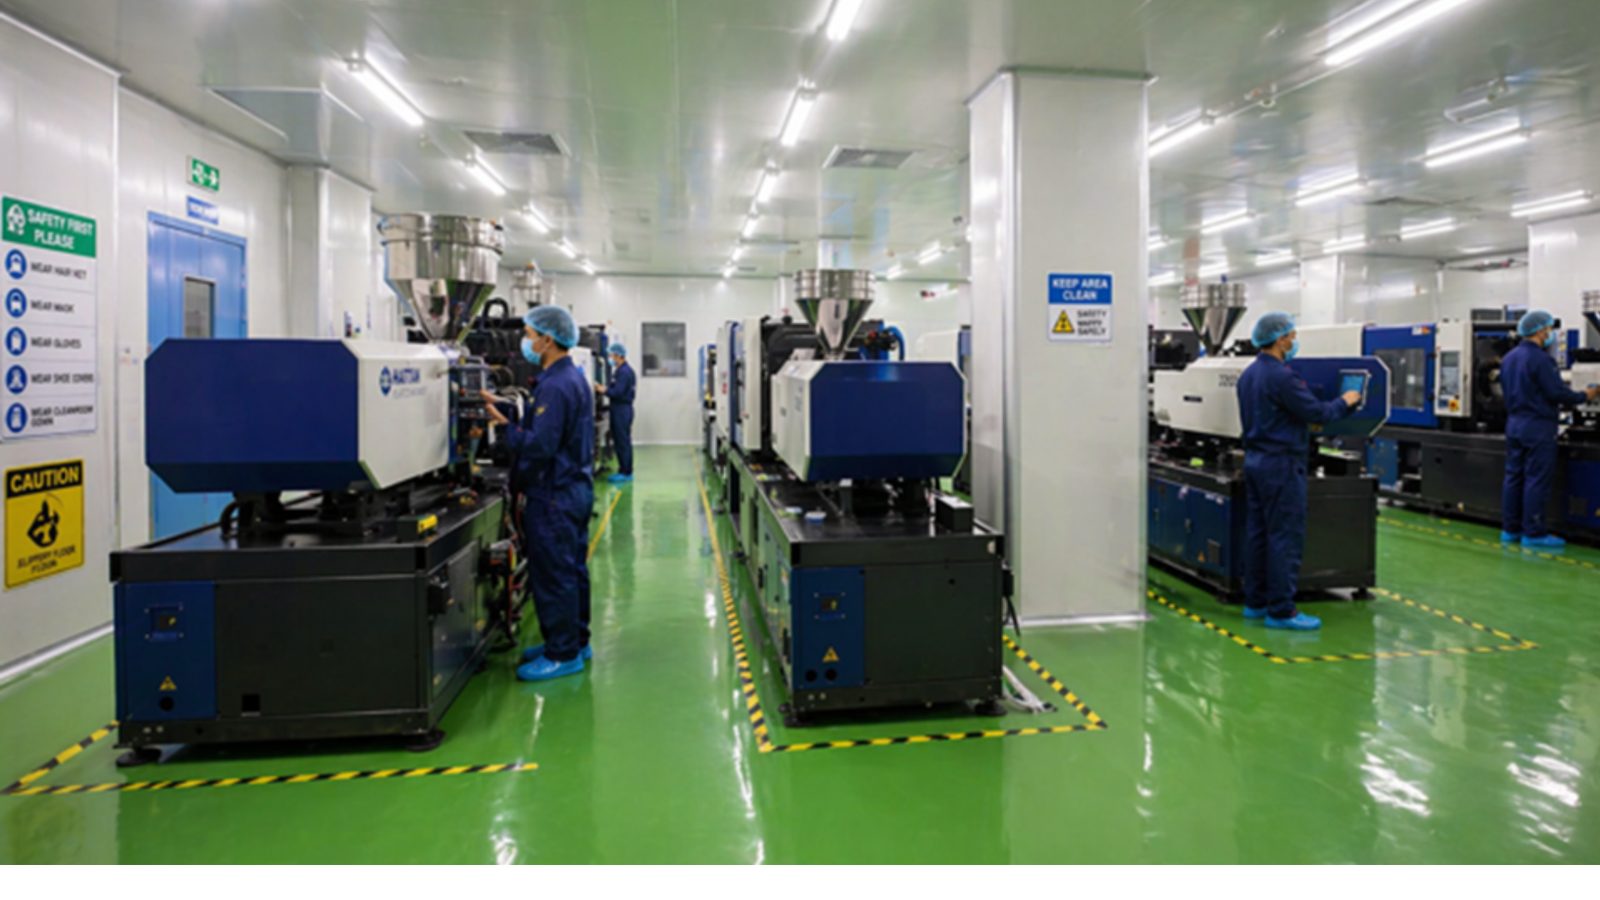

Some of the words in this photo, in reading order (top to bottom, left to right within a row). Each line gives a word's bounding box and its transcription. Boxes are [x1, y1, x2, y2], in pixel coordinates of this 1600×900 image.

[28, 209, 64, 229] SAFETY
[68, 219, 93, 235] FIRST
[34, 229, 74, 249] PLEASE
[31, 262, 52, 273] WEAR
[1052, 278, 1079, 288] KEEP
[1081, 278, 1108, 288] AREA
[1062, 290, 1097, 300] CLEAN
[31, 300, 52, 311] WEAR
[31, 337, 52, 348] WEAR
[31, 373, 52, 384] WEAR
[31, 406, 52, 417] WEAR
[11, 466, 79, 492] CAUTION
